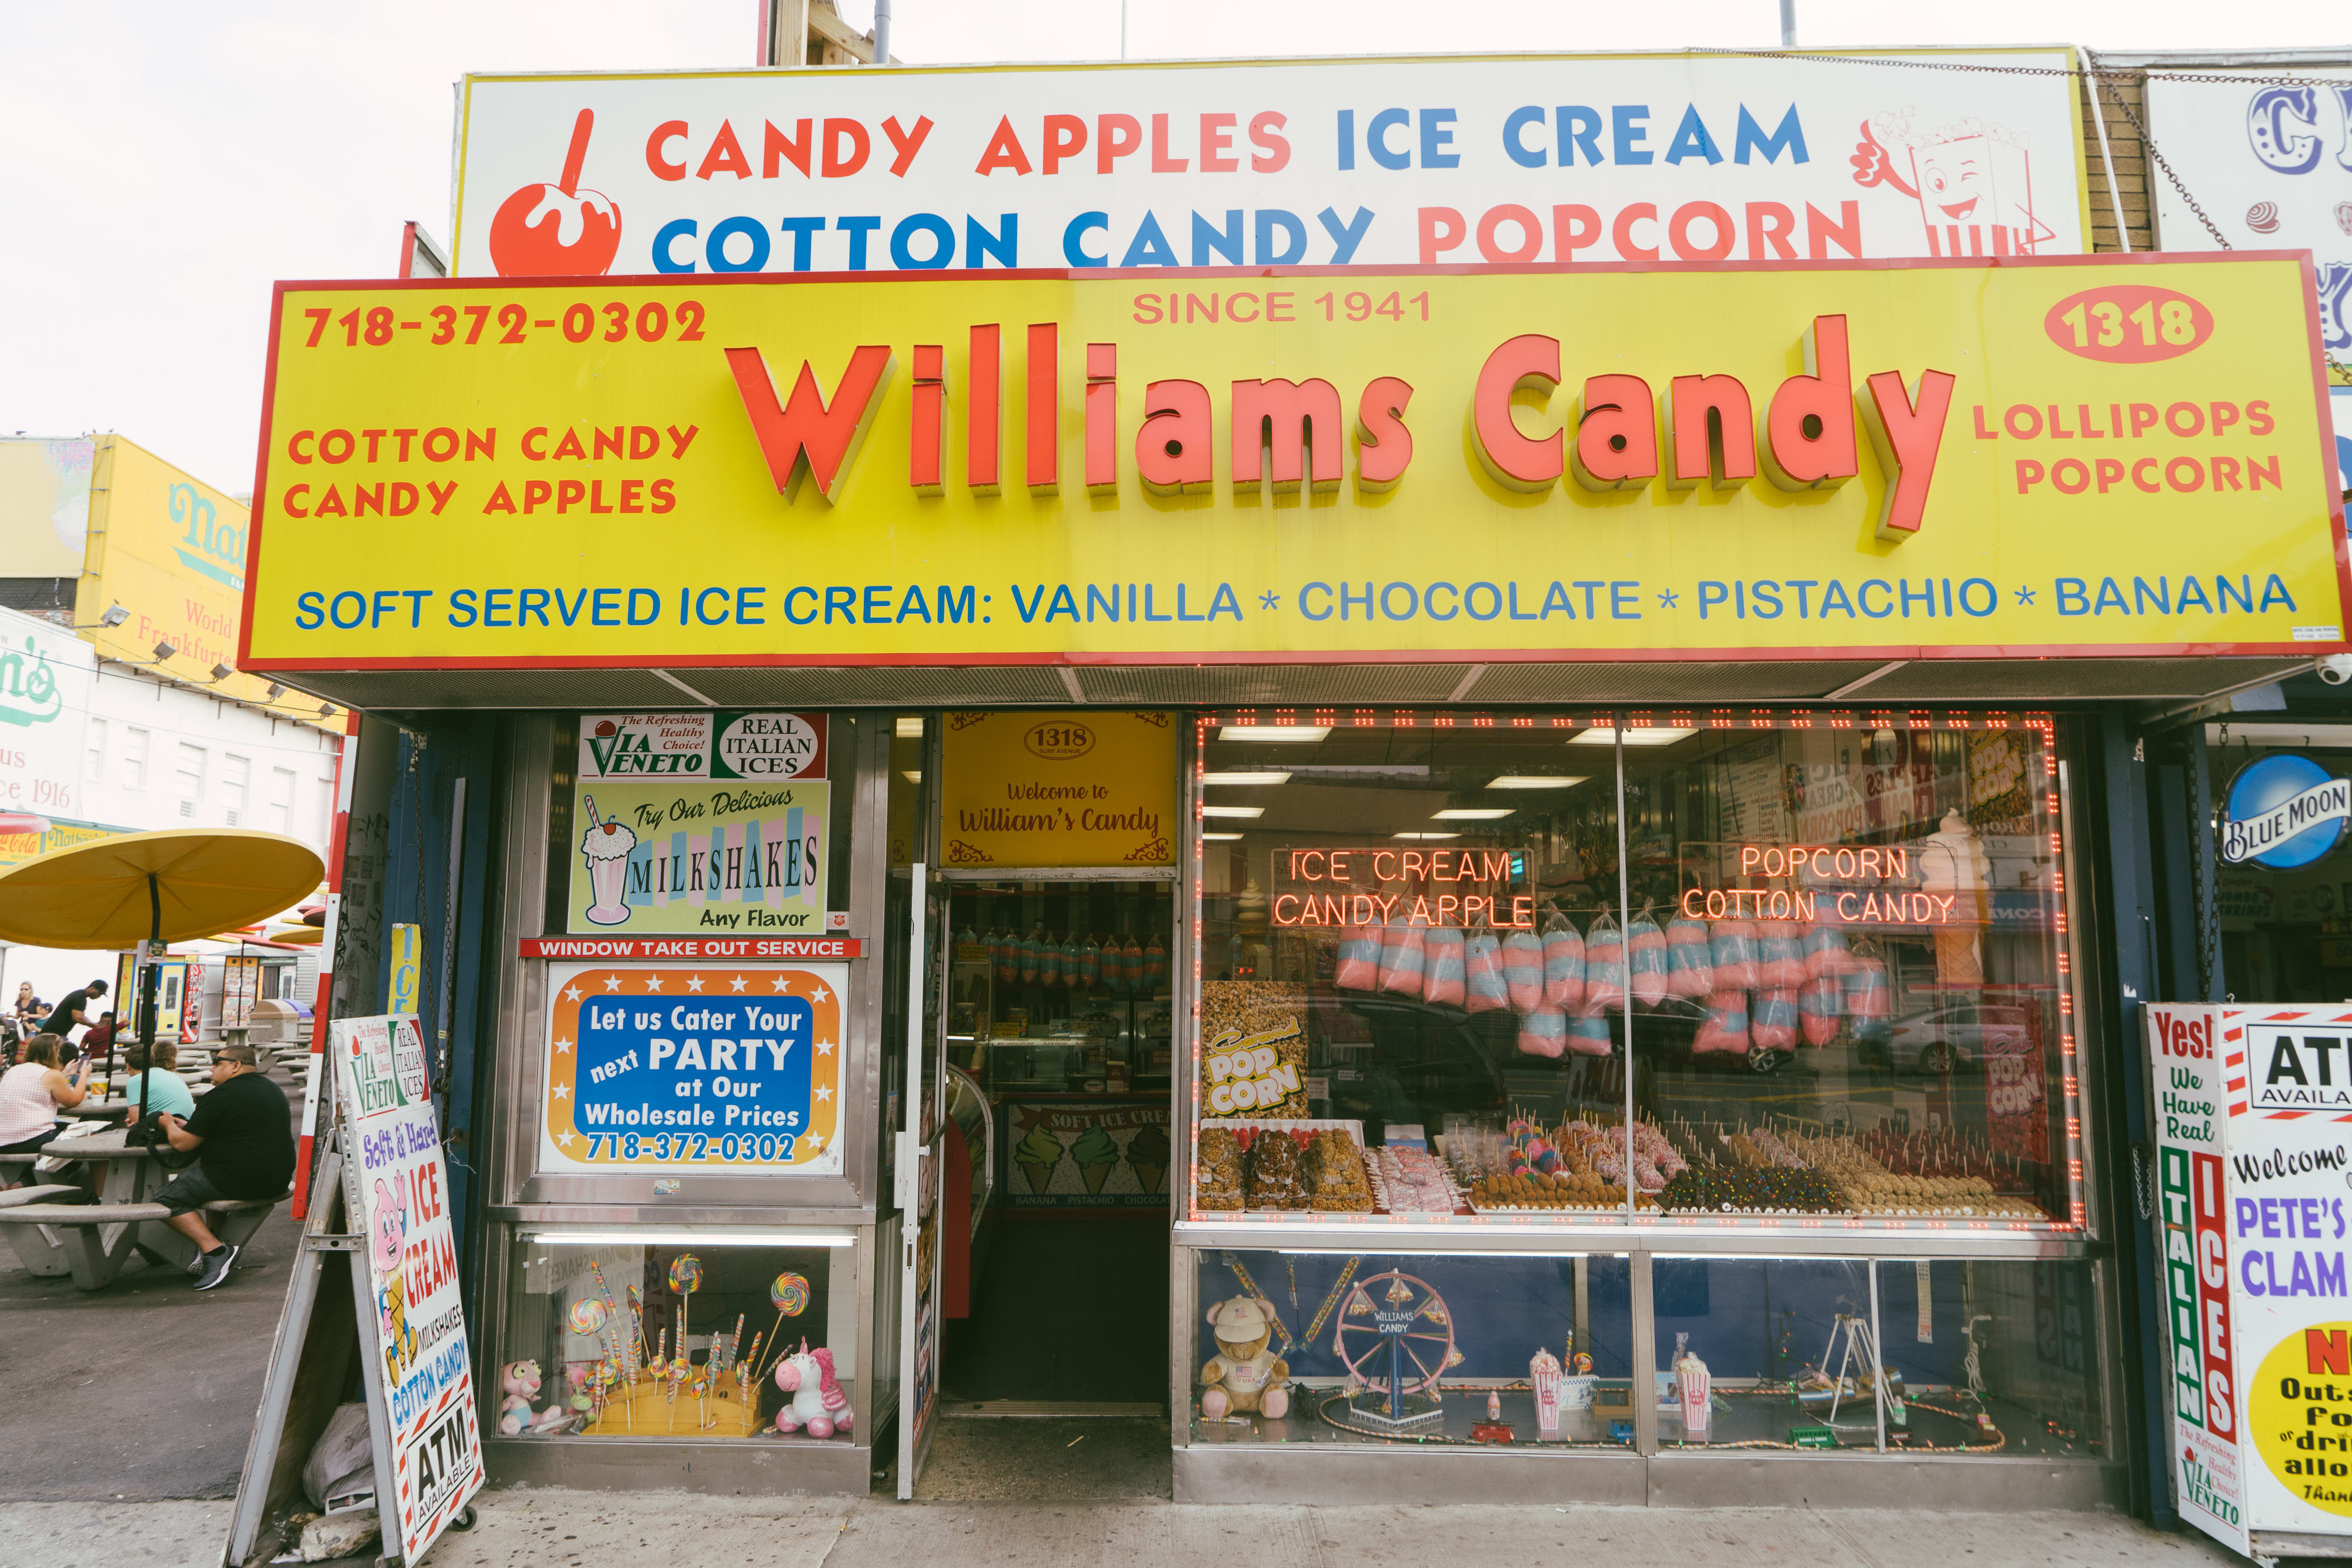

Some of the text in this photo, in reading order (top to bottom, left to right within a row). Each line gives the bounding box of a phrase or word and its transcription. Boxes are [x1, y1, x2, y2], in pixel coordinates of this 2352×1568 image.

[646, 101, 1810, 181] CANDY APPLES ICE CREAM
[652, 199, 1863, 274] COTTON CANDY POPCORN
[303, 300, 706, 347] 718-372-0302
[1132, 290, 1430, 324] SINCE 1941
[2061, 300, 2196, 347] 1318
[723, 313, 1956, 535] Williams Candy
[1972, 400, 2276, 440] LOLLIPOPS
[288, 424, 700, 465] COTTON CANDY
[2015, 455, 2282, 494] POPCORN
[283, 478, 676, 519] CANDY APPLES
[185, 599, 232, 639] World
[295, 574, 2297, 630] SOFT SERVED ICE CREAM: VANILLA CHOCOLATE PISTACHIO BANANA
[621, 715, 705, 727] The Refreshing
[659, 727, 705, 740] Healthy
[741, 718, 799, 735] REAL
[1034, 728, 1087, 746] 1318
[663, 739, 706, 751] Choice!
[726, 738, 813, 754] ITALIAN
[1971, 738, 2009, 778] POP
[738, 757, 799, 774] ICES
[1974, 750, 2024, 805] CORN
[31, 778, 70, 808] 1916
[1008, 782, 1110, 800] Welcome to
[634, 788, 794, 831] Try Our Delicious
[959, 807, 1159, 839] William's Candy
[2225, 786, 2347, 861] BLUE MOON
[630, 835, 818, 895] MILKSHAKES
[1291, 851, 1511, 882] ICE CREAM
[1742, 847, 1907, 880] POPCORN
[699, 908, 810, 929] Any Flavor
[1275, 894, 1533, 927] CANDY APPLE
[1683, 888, 1957, 924] COTTON CANDY
[539, 942, 844, 956] WINDOW TAKE OUT SERVICE
[367, 1022, 388, 1039] Refreshing
[590, 1005, 802, 1031] Let us Cater Your
[1211, 1017, 1302, 1054] Caramel
[2154, 1011, 2213, 1059] Yes!
[375, 1040, 390, 1056] Healthy
[397, 1027, 417, 1048] REAL
[649, 1038, 796, 1071] PARTY
[1987, 1032, 2034, 1057] Pink
[396, 1050, 425, 1074] ITALIAN
[589, 1048, 640, 1084] next
[1207, 1045, 1278, 1084] POP
[1990, 1055, 2025, 1086] POP
[2170, 1067, 2203, 1089] We
[2266, 1035, 2352, 1086] AT
[403, 1075, 424, 1098] ICES
[675, 1076, 762, 1098] at Our
[1208, 1061, 1302, 1113] CORN
[1990, 1072, 2042, 1115] CORN
[2163, 1091, 2216, 1116] Have
[584, 1104, 799, 1126] Wholesale Prices
[1051, 1112, 1093, 1129] SOFT
[1098, 1111, 1127, 1126] ICE
[2167, 1116, 2216, 1142] Real
[363, 1117, 437, 1169] Soft & Hard
[585, 1132, 796, 1162] 718-372-0302
[2234, 1145, 2347, 1185] Welcome
[409, 1161, 440, 1228] ICE
[1015, 1196, 1057, 1205] BANANA
[1068, 1196, 1114, 1205] PISTACHIO
[2234, 1196, 2346, 1239] PETE'S
[405, 1227, 457, 1310] CREAM
[2241, 1250, 2347, 1297] CLAM
[2165, 1154, 2201, 1422] ITALIAN
[2200, 1159, 2232, 1433] ICES
[418, 1303, 463, 1354] MILKSHAKES
[1374, 1311, 1414, 1322] WILLIAMS
[1379, 1323, 1409, 1334] CANDY
[392, 1336, 467, 1430] COTTON CANDY
[418, 1405, 468, 1503] ATM
[2179, 1423, 2236, 1466] The Refreshing
[2209, 1457, 2237, 1482] Healthy
[418, 1455, 472, 1524] AVAILABLE
[2211, 1475, 2239, 1500] Choice!
